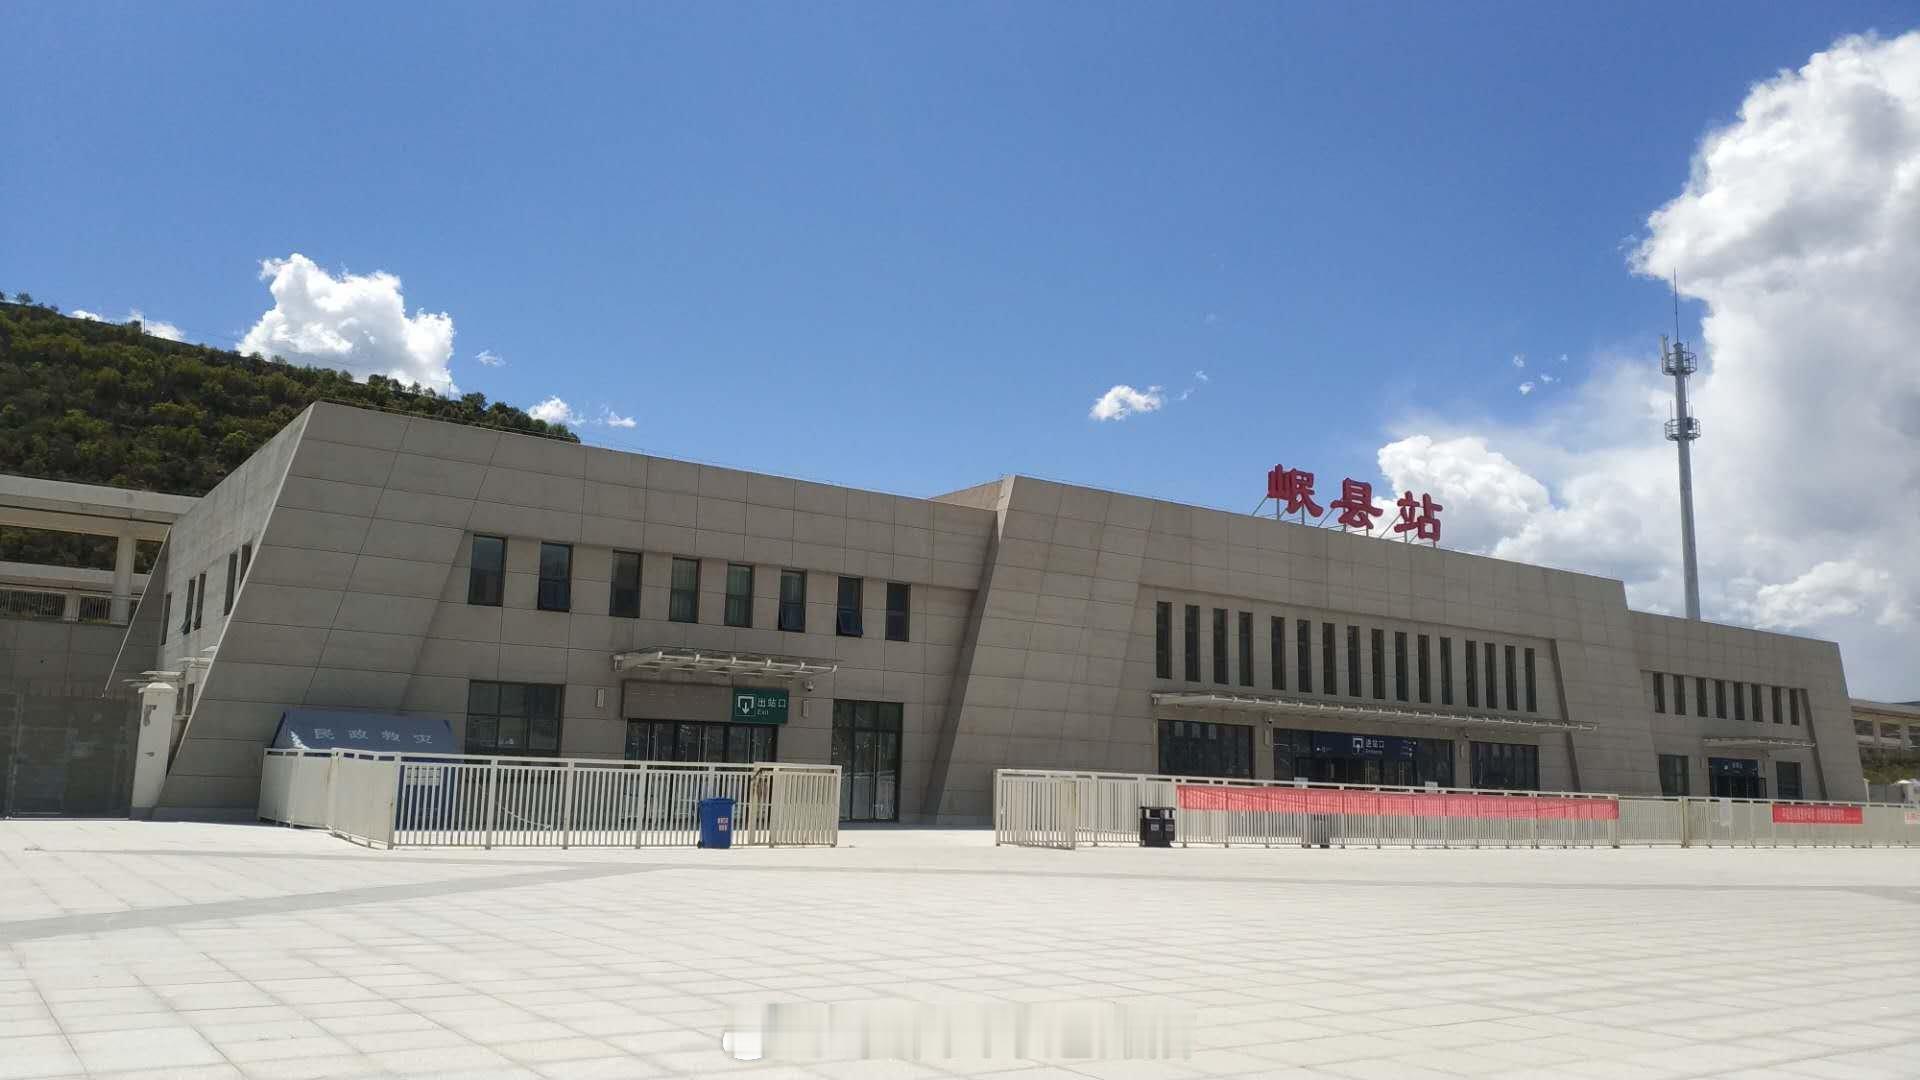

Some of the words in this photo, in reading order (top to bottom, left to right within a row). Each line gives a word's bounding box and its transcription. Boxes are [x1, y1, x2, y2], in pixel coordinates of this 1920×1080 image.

[1267, 464, 1443, 542] 岷县站
[756, 697, 786, 708] 出站口
[313, 727, 433, 744] 民政救灾
